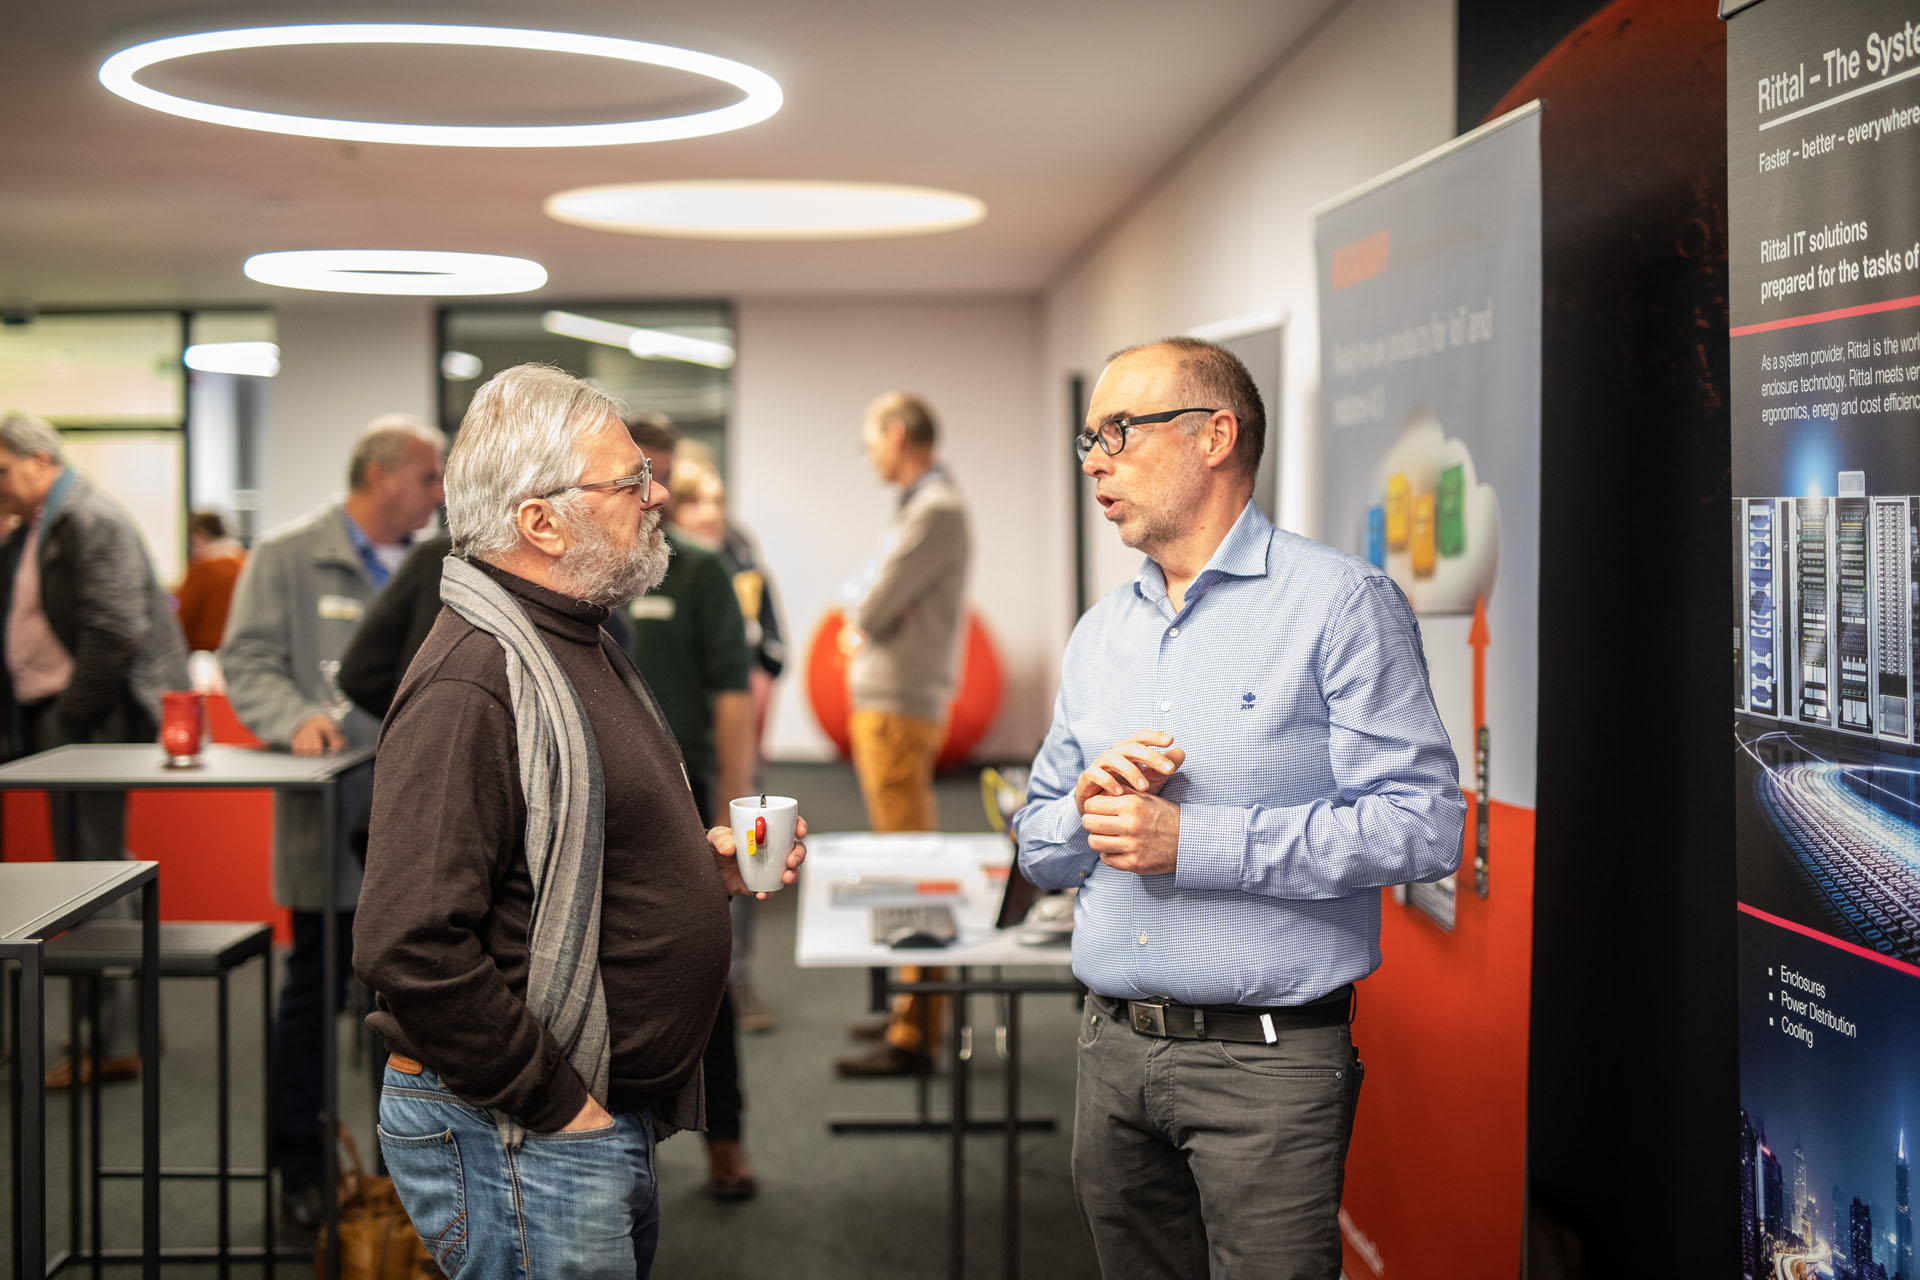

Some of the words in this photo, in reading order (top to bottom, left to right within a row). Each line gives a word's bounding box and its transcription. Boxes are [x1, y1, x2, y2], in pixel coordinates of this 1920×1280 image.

[1758, 62, 1804, 114] Rittal
[1823, 47, 1860, 88] The
[1866, 20, 1920, 76] Syste
[1759, 148, 1791, 173] Faster
[1802, 133, 1836, 159] better
[1847, 104, 1920, 145] everywhere
[1760, 234, 1790, 264] Rittal
[1793, 230, 1806, 256] IT
[1808, 220, 1868, 253] solutions
[1760, 265, 1815, 305] prepared
[1817, 263, 1836, 288] for
[1838, 258, 1859, 284] the
[1862, 247, 1901, 279] tasks
[1904, 242, 1920, 270] of
[1761, 354, 1772, 372] As
[1772, 356, 1779, 370] a
[1779, 351, 1809, 373] system
[1810, 343, 1846, 369] provider,
[1847, 338, 1871, 360] Rittal
[1873, 338, 1882, 357] is
[1883, 336, 1899, 355] the
[1900, 331, 1920, 353] worl
[1761, 378, 1799, 397] enclosure
[1800, 371, 1847, 393] technology.
[1849, 366, 1873, 388] Rittal
[1875, 364, 1904, 383] meets
[1761, 402, 1810, 426] ergonomics,
[1812, 402, 1840, 421] energy
[1841, 396, 1858, 416] and
[1860, 395, 1882, 414] cost
[1780, 964, 1826, 999] Enclosures
[1781, 990, 1808, 1016] Power
[1809, 1001, 1857, 1039] Distribution
[1781, 1015, 1814, 1049] Cooling
